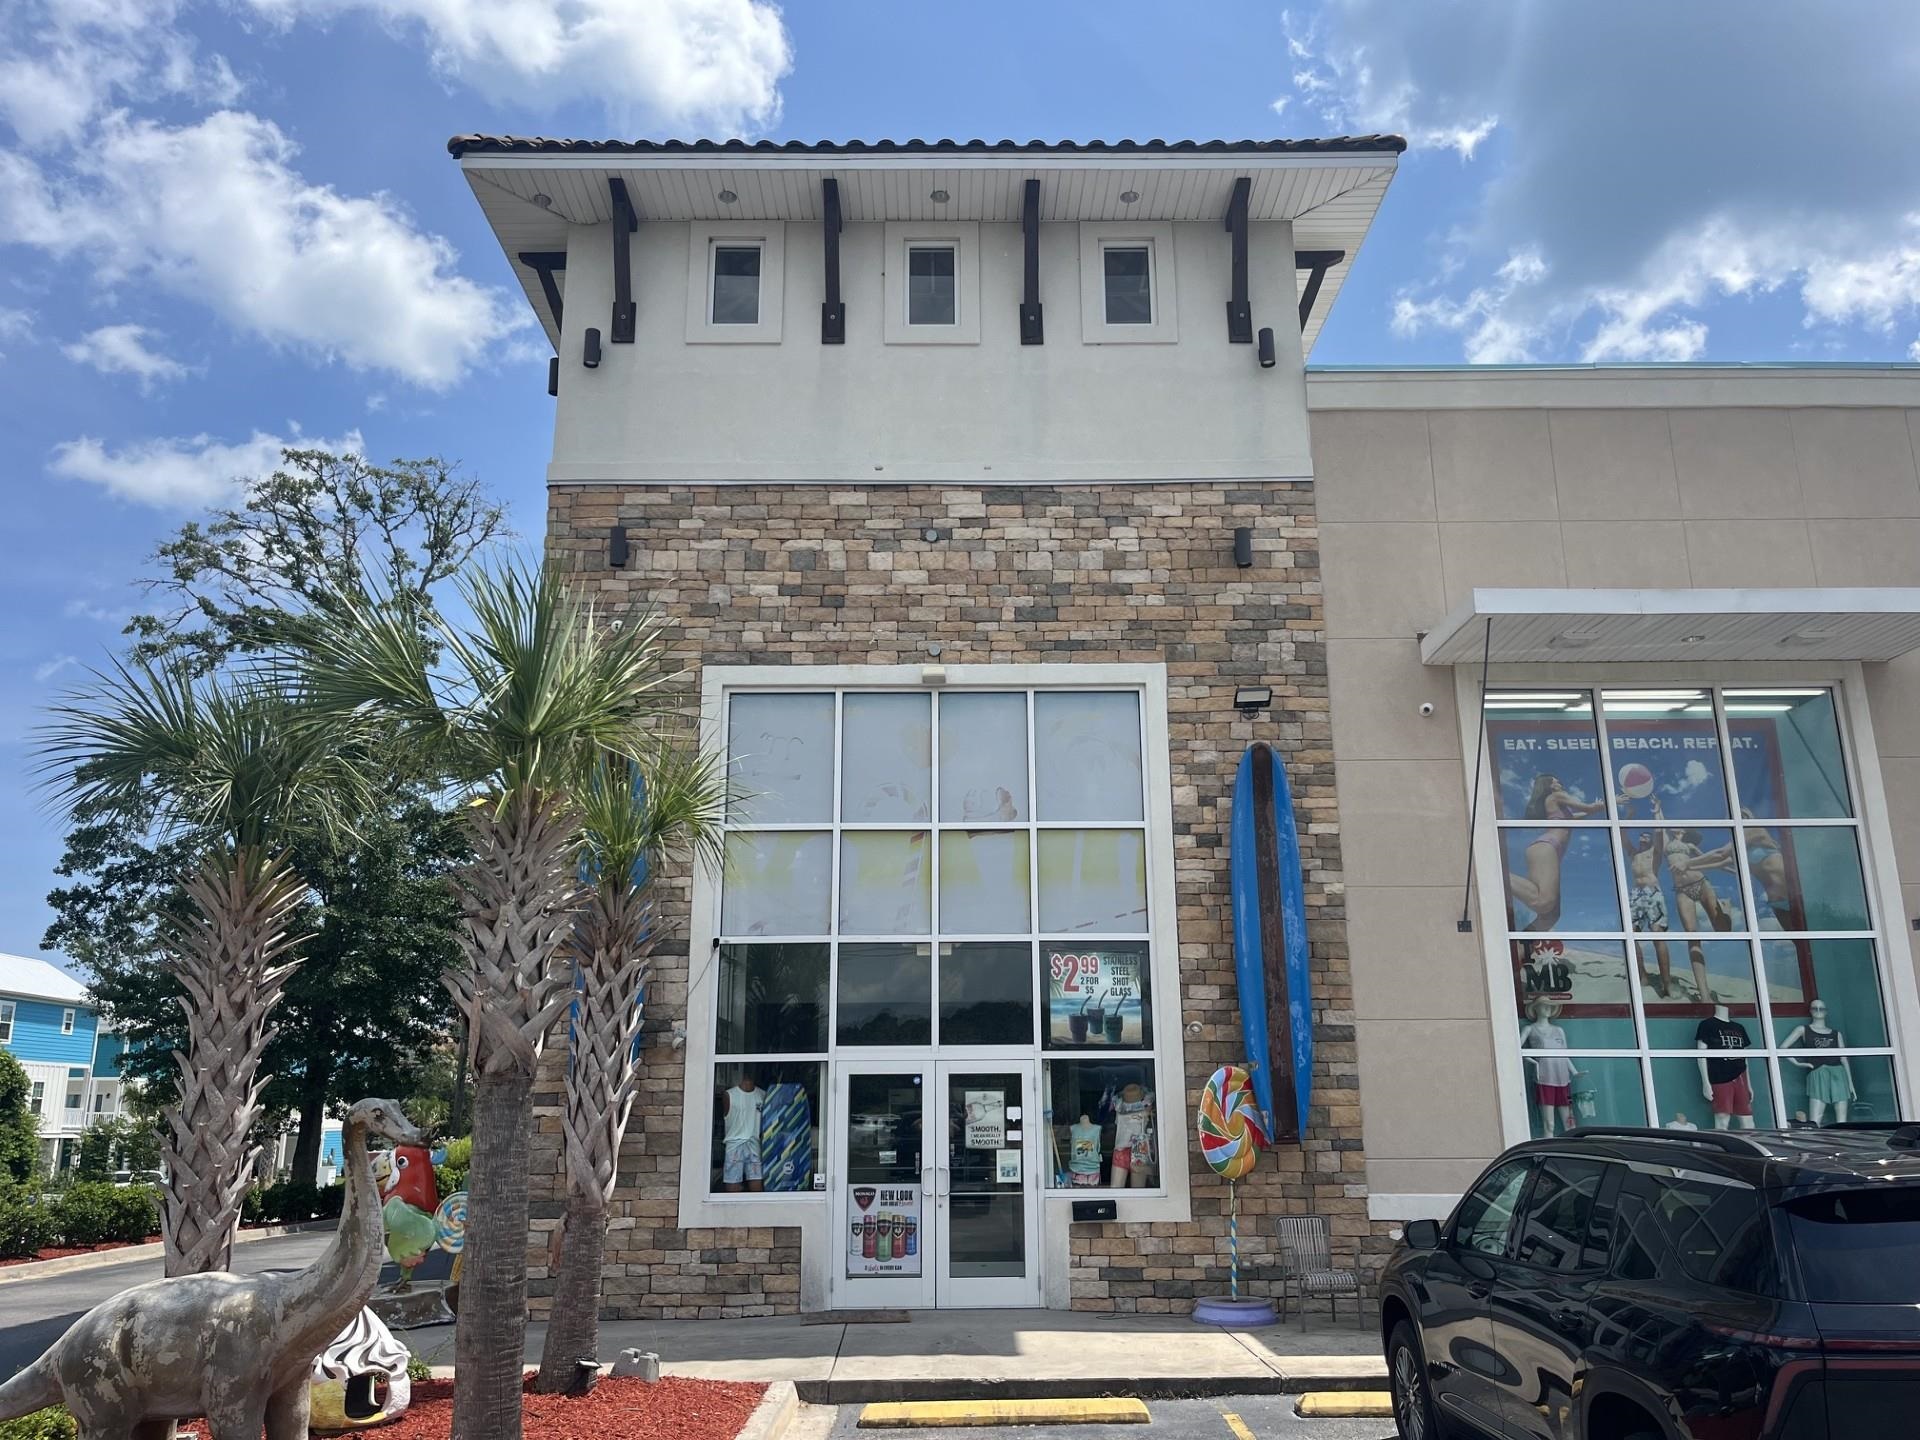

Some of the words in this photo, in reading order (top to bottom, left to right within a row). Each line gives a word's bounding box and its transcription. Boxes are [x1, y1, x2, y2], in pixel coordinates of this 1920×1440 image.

[1504, 738, 1542, 750] EAT.
[1613, 737, 1679, 749] BEACH.
[1684, 737, 1758, 749] REPAT.
[1103, 956, 1138, 965] STAINLESS
[1111, 967, 1130, 975] STEEL
[1112, 977, 1129, 986] SHOT
[1110, 987, 1132, 996] GLASS
[880, 1190, 895, 1200] NEW
[896, 1190, 913, 1200] LOOK
